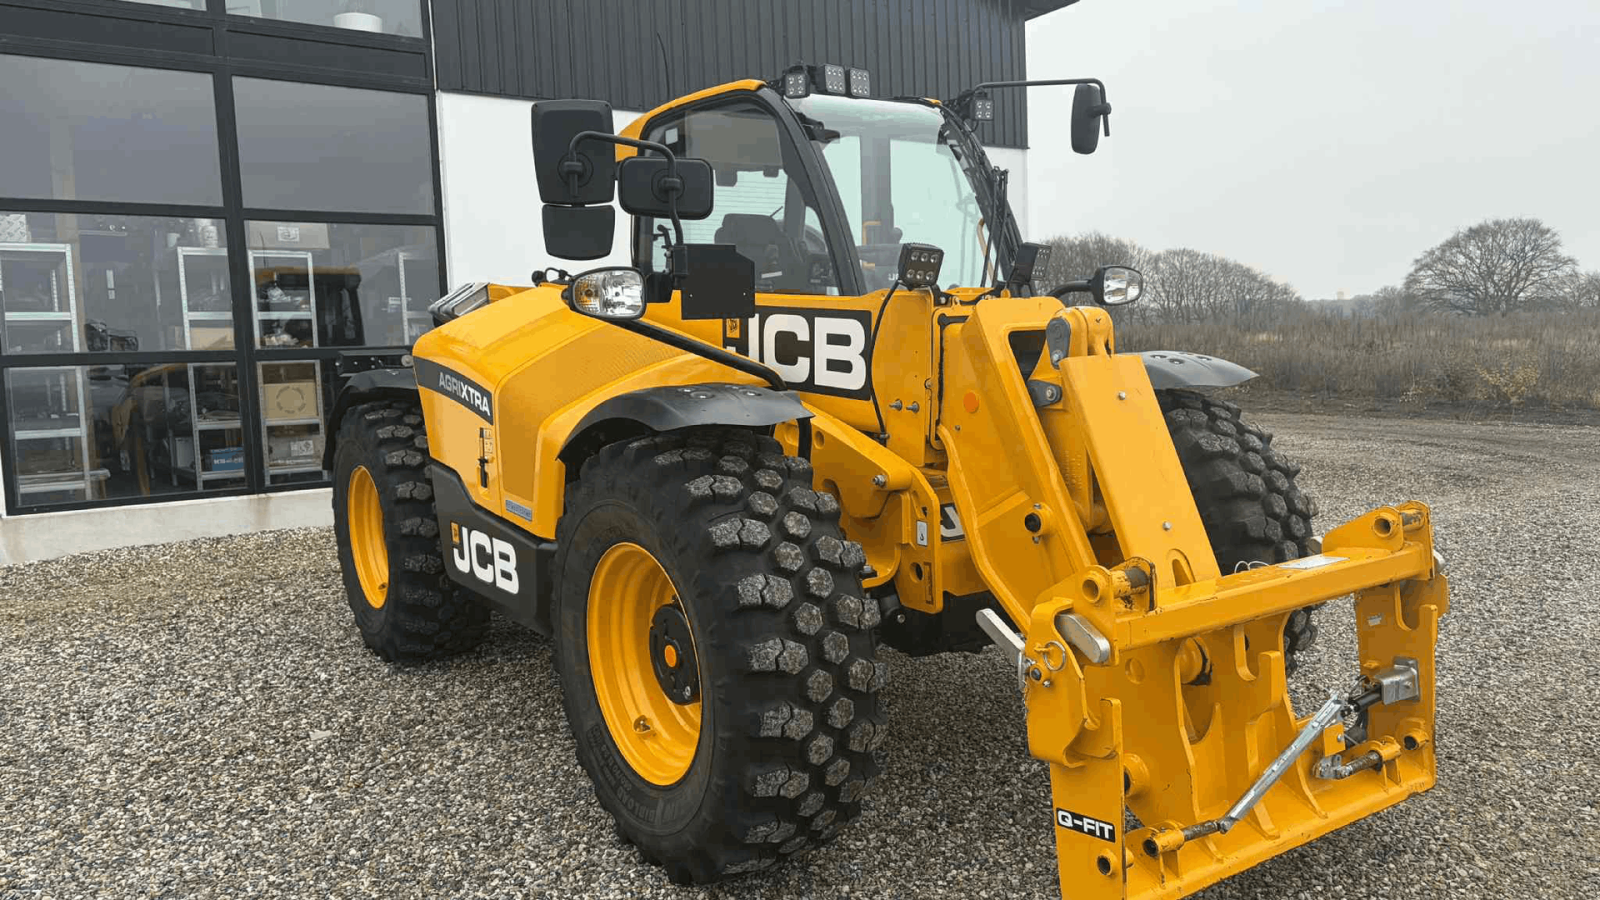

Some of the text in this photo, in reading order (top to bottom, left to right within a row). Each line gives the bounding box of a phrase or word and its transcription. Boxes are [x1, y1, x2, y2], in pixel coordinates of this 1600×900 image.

[438, 371, 491, 417] AGRIXTRA
[453, 526, 519, 595] JCB
[1057, 810, 1114, 839] Q-FIT
